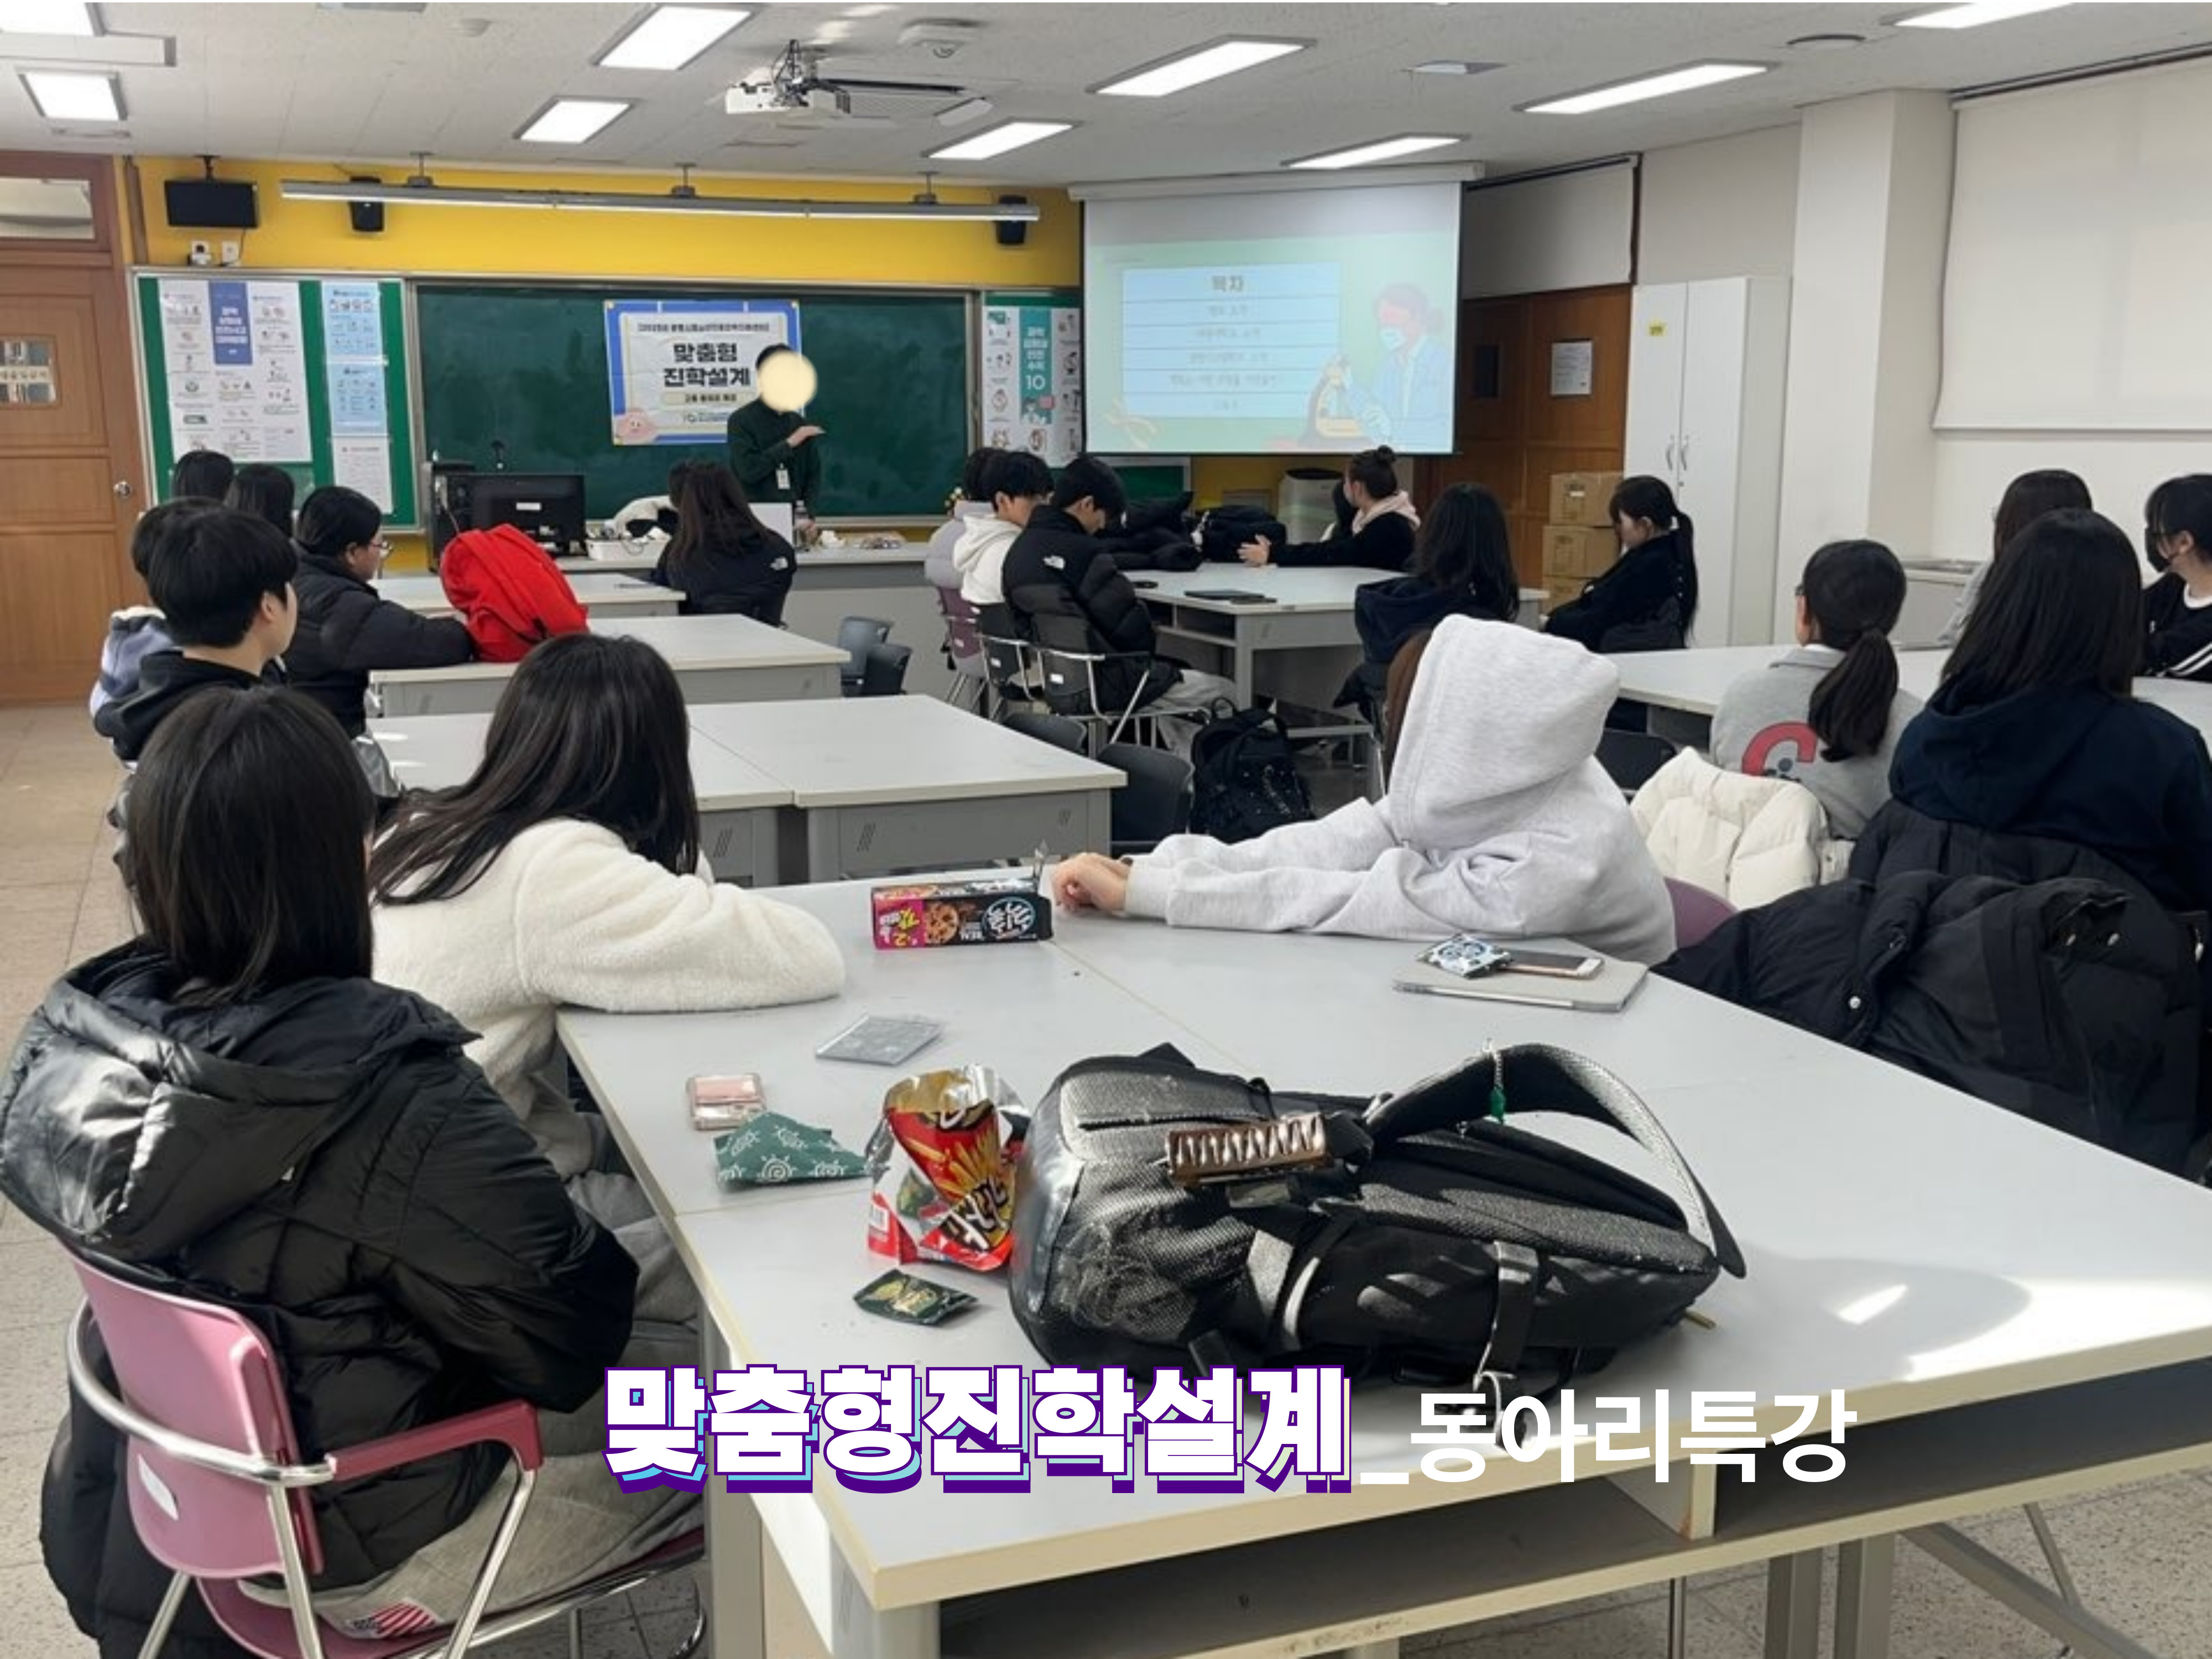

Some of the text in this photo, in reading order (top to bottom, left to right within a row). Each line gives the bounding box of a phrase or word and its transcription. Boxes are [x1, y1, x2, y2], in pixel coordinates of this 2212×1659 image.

[673, 342, 737, 363] 맞춤형
[664, 367, 751, 387] 진학설계
[1026, 375, 1045, 390] 10
